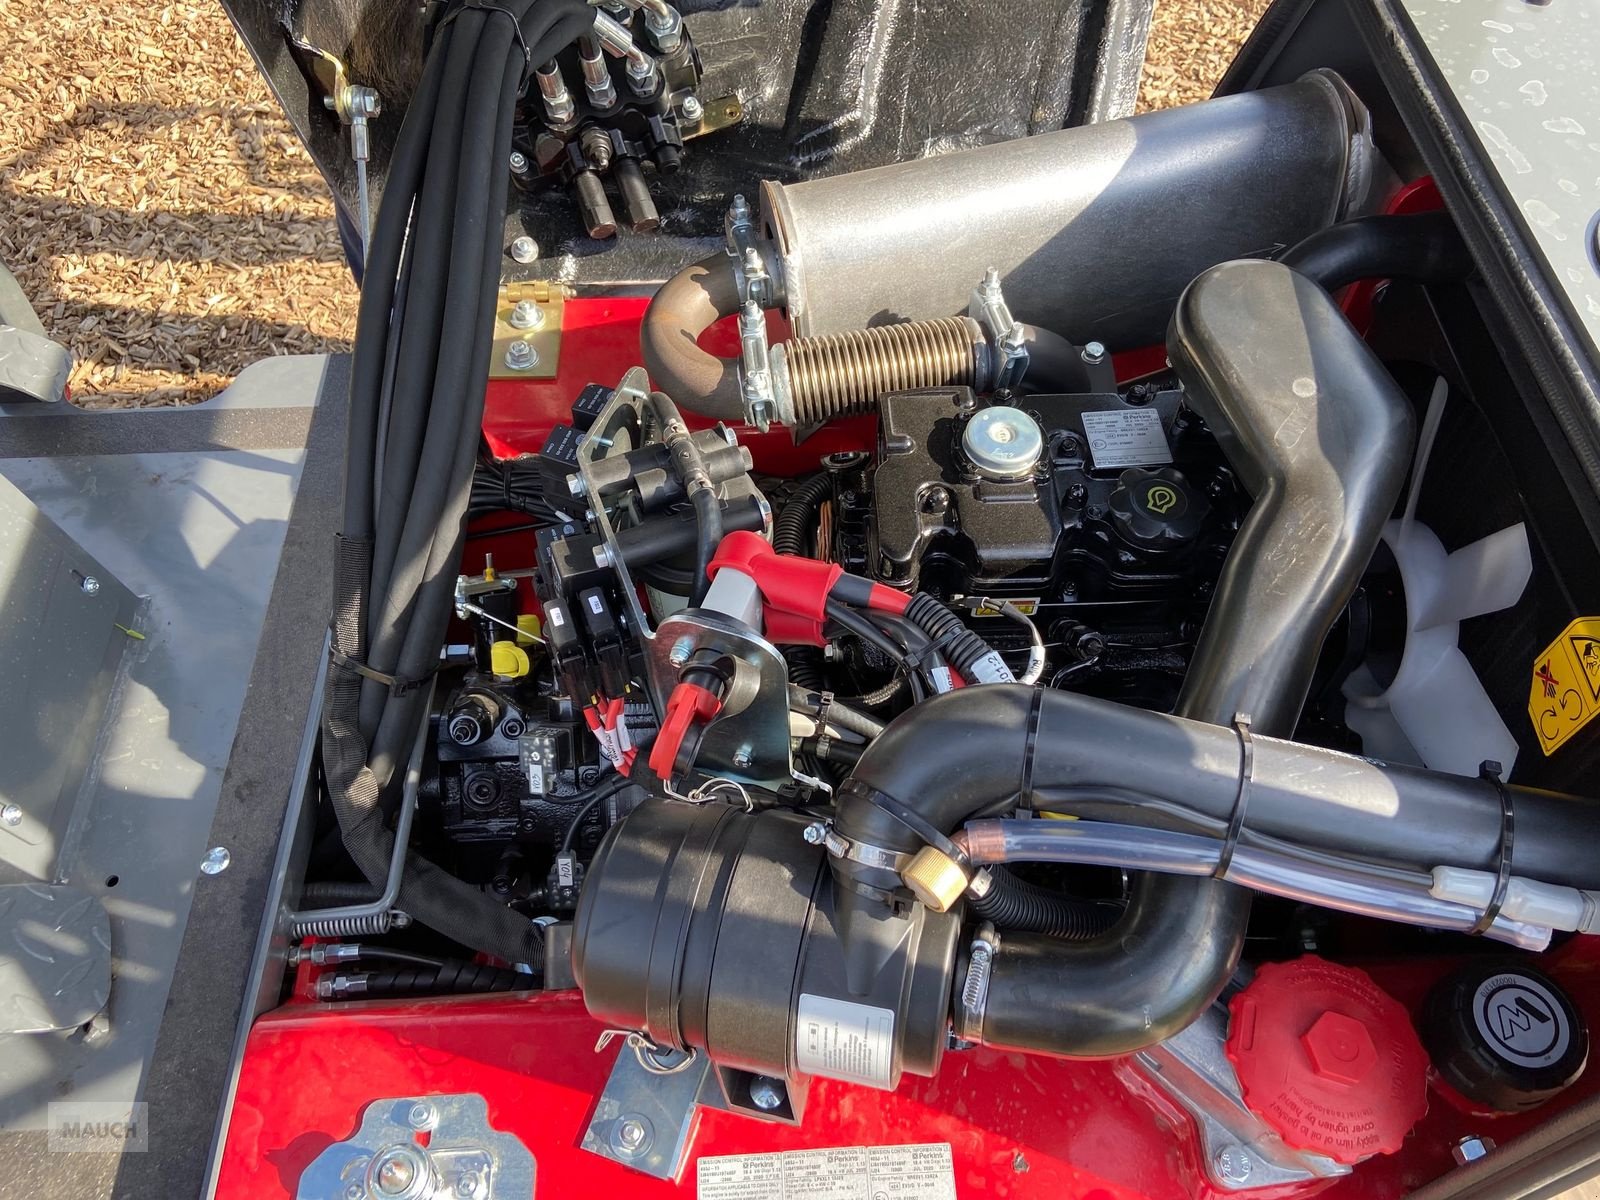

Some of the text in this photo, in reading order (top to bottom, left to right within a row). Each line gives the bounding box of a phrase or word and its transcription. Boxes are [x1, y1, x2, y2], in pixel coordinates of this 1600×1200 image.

[560, 861, 570, 880] Y04
[1278, 1092, 1303, 1117] hand
[1270, 1102, 1301, 1128] gasket
[1305, 1112, 1316, 1126] by
[1300, 1125, 1309, 1137] to
[1318, 1119, 1349, 1134] tighten
[1352, 1121, 1375, 1133] cover
[1311, 1131, 1322, 1141] oil
[1324, 1136, 1334, 1145] of
